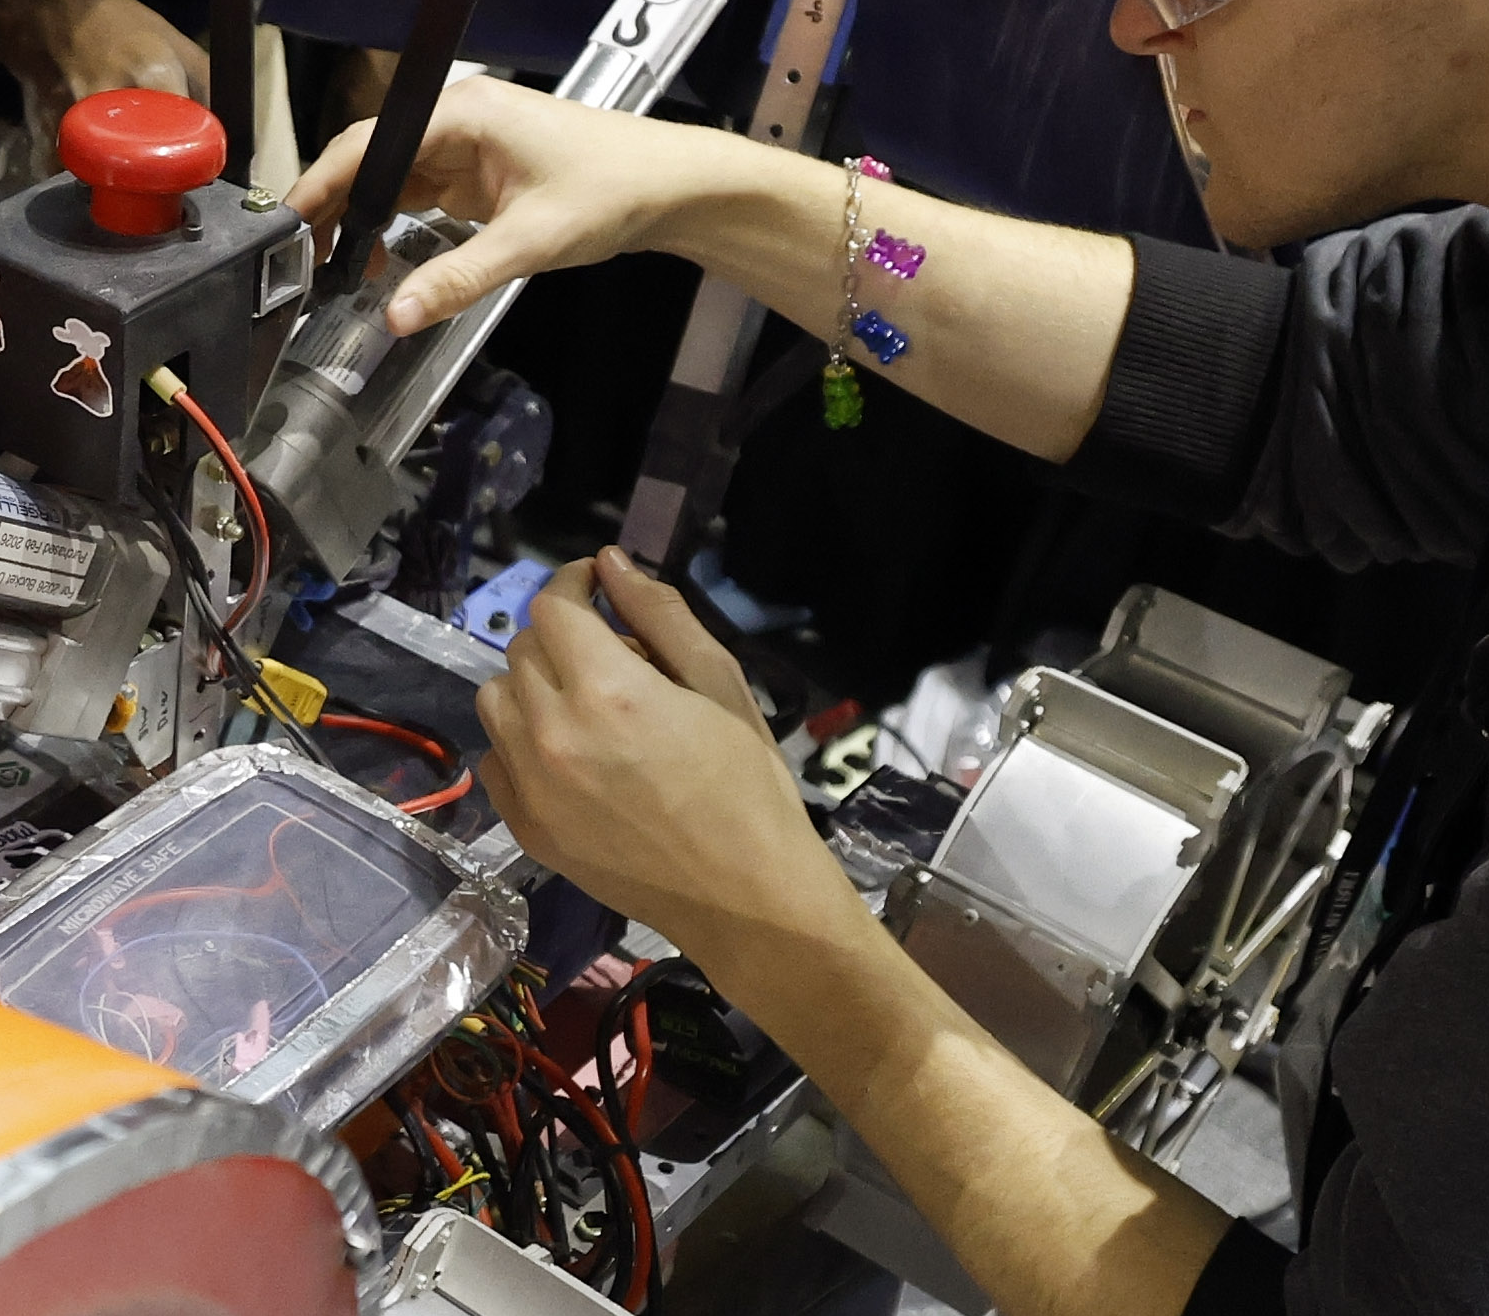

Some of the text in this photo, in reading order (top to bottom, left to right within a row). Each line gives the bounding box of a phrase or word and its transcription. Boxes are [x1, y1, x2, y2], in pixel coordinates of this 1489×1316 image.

[804, 0, 823, 23] up
[0, 533, 88, 564] Purchased Feb 2026
[5, 573, 38, 591] Bucket
[60, 585, 76, 599] For
[57, 841, 183, 935] MICROWAVE SAFE
